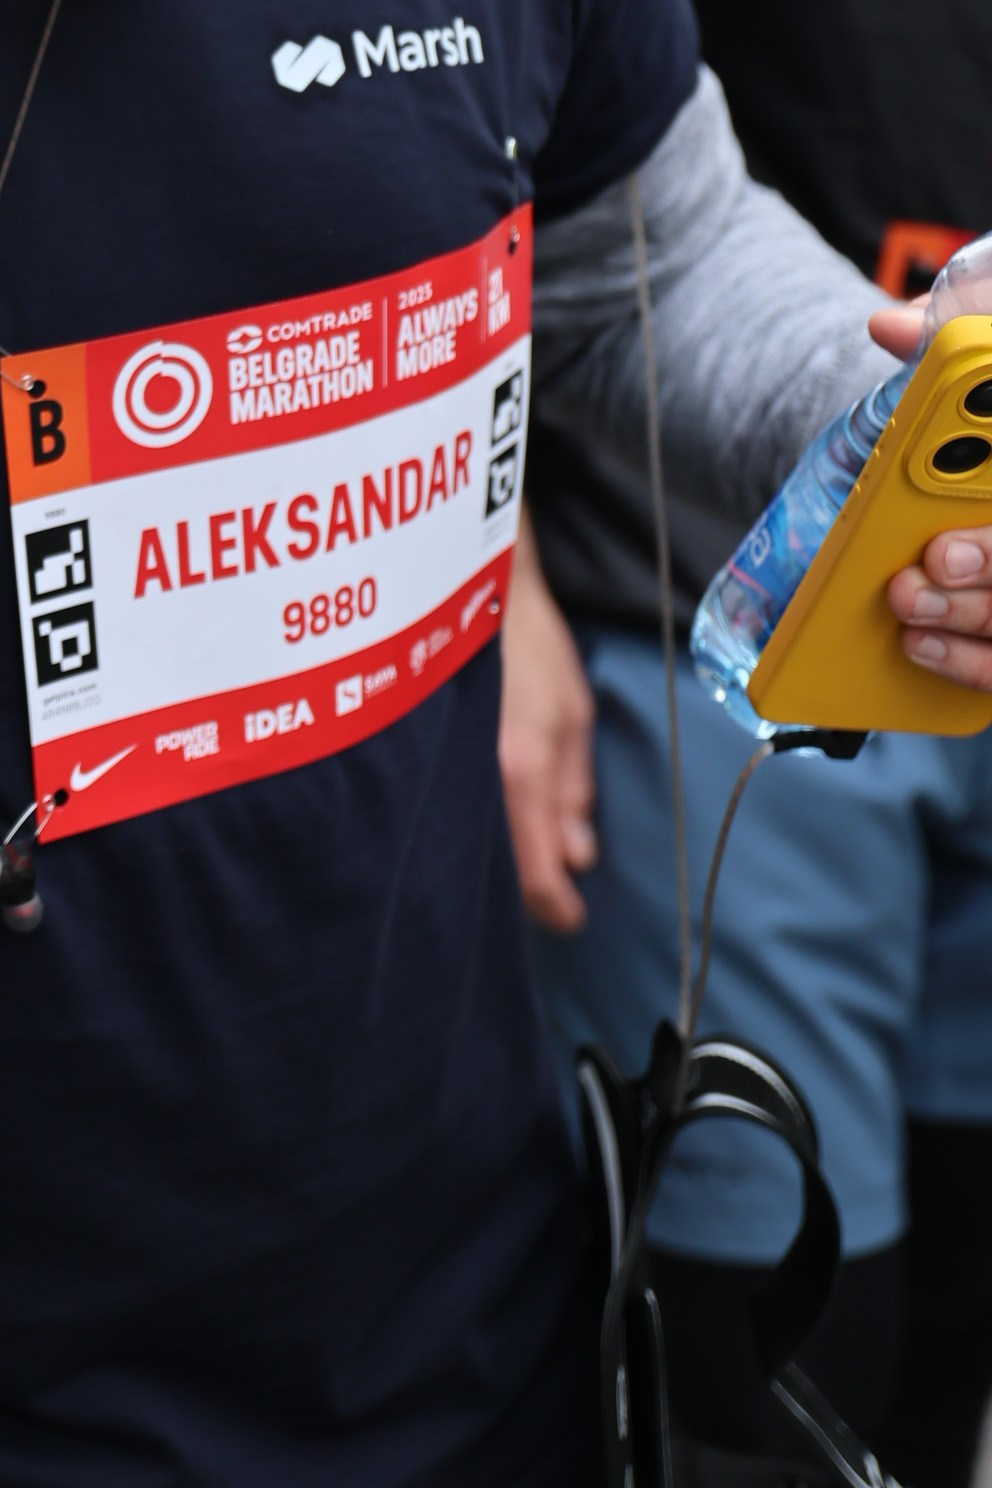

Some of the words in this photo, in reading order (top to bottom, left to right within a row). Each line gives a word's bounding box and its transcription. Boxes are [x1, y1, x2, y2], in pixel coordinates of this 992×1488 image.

[352, 16, 485, 78] Marsh
[267, 301, 373, 343] COMTRADE
[397, 288, 478, 349] ALWAYS
[398, 281, 433, 310] 2025
[229, 330, 360, 392] BELGRADE
[396, 329, 457, 381] MORE
[230, 358, 374, 425] MARATHON
[29, 399, 66, 467] B
[133, 429, 473, 599] ALEKSANDAR
[282, 575, 377, 644] 9880
[155, 720, 219, 755] POWER
